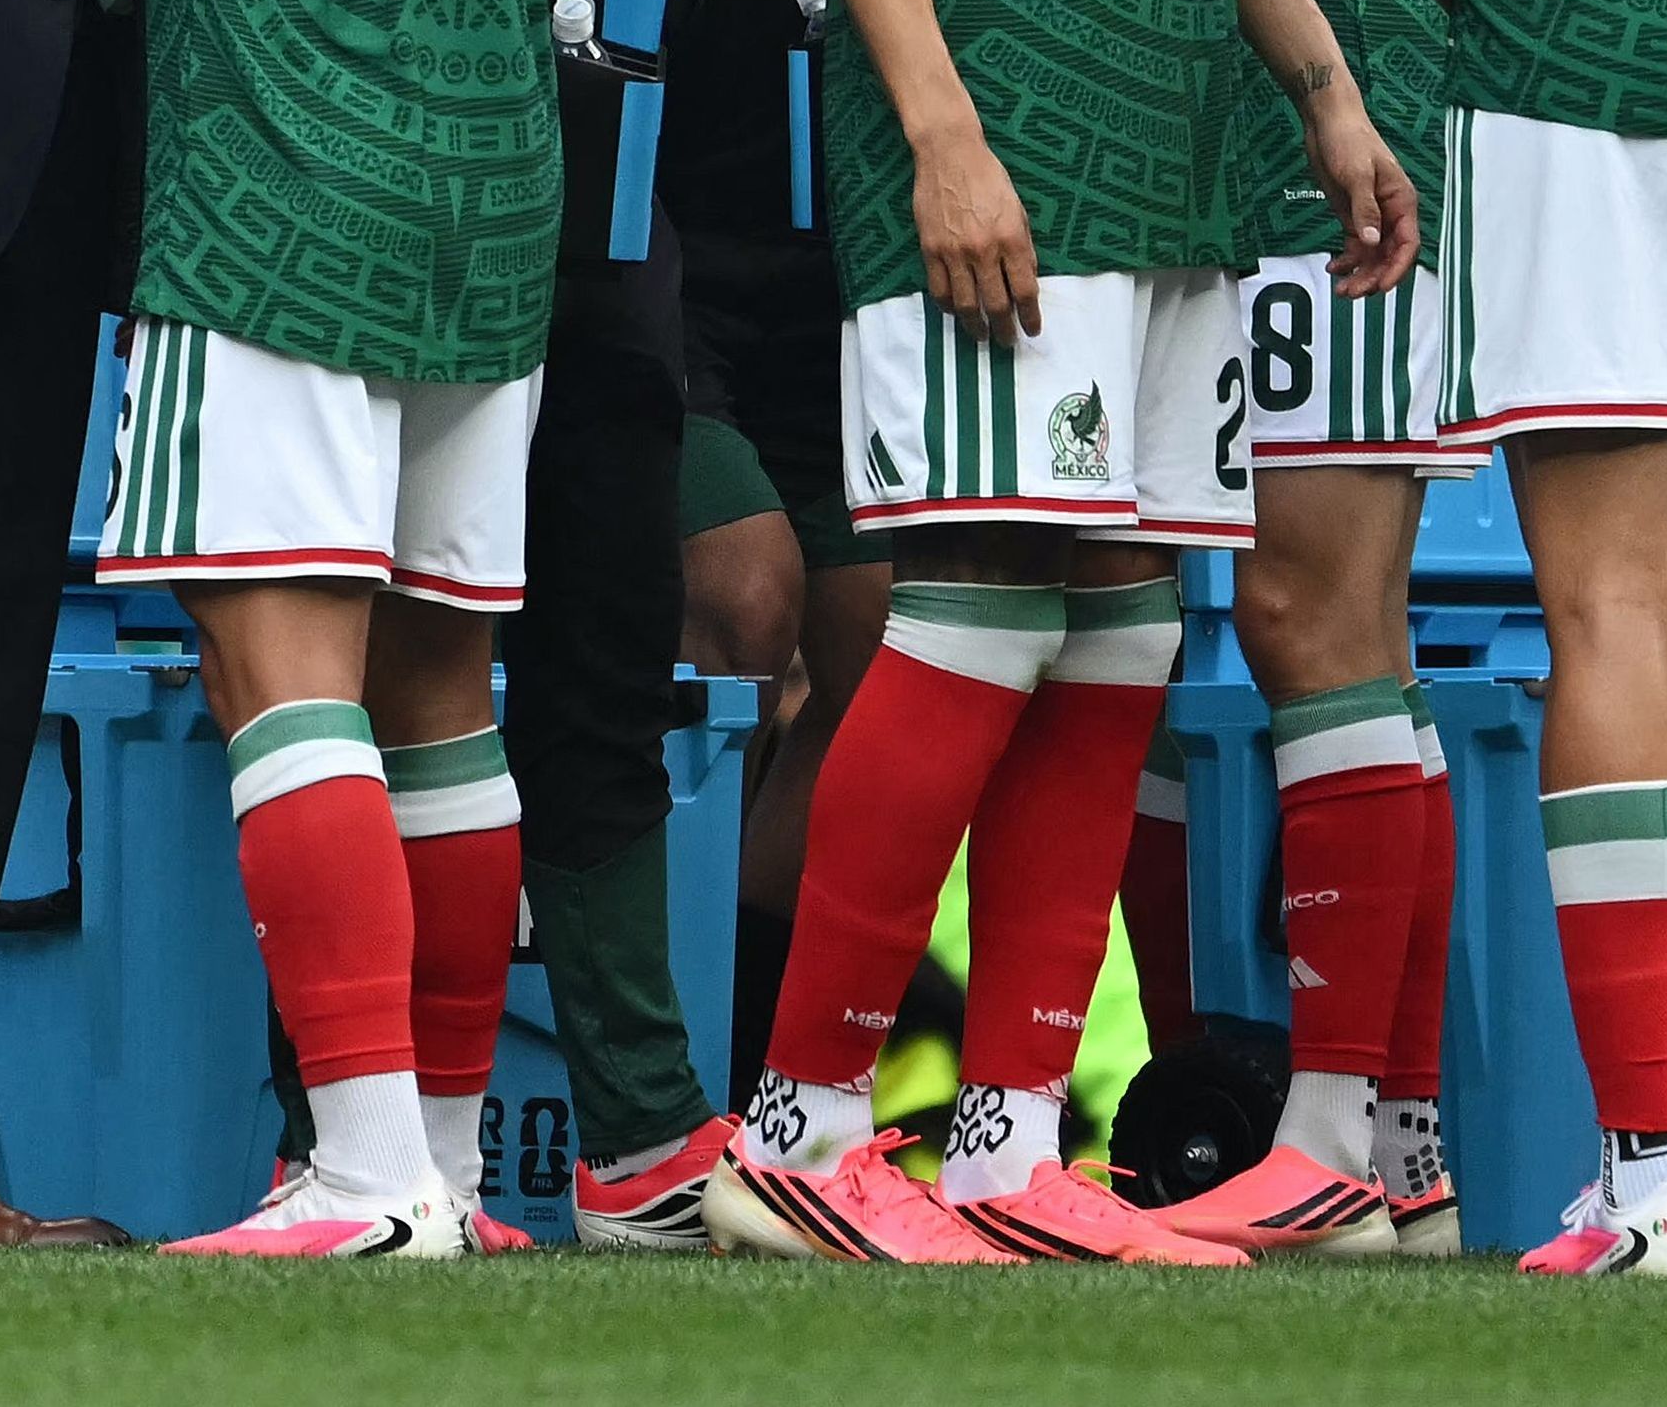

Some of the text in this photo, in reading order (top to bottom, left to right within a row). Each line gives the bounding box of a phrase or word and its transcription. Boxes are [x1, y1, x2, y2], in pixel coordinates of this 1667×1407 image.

[1250, 281, 1313, 413] 8
[1054, 460, 1107, 477] MÉXICO
[1032, 1007, 1087, 1030] MÉXI
